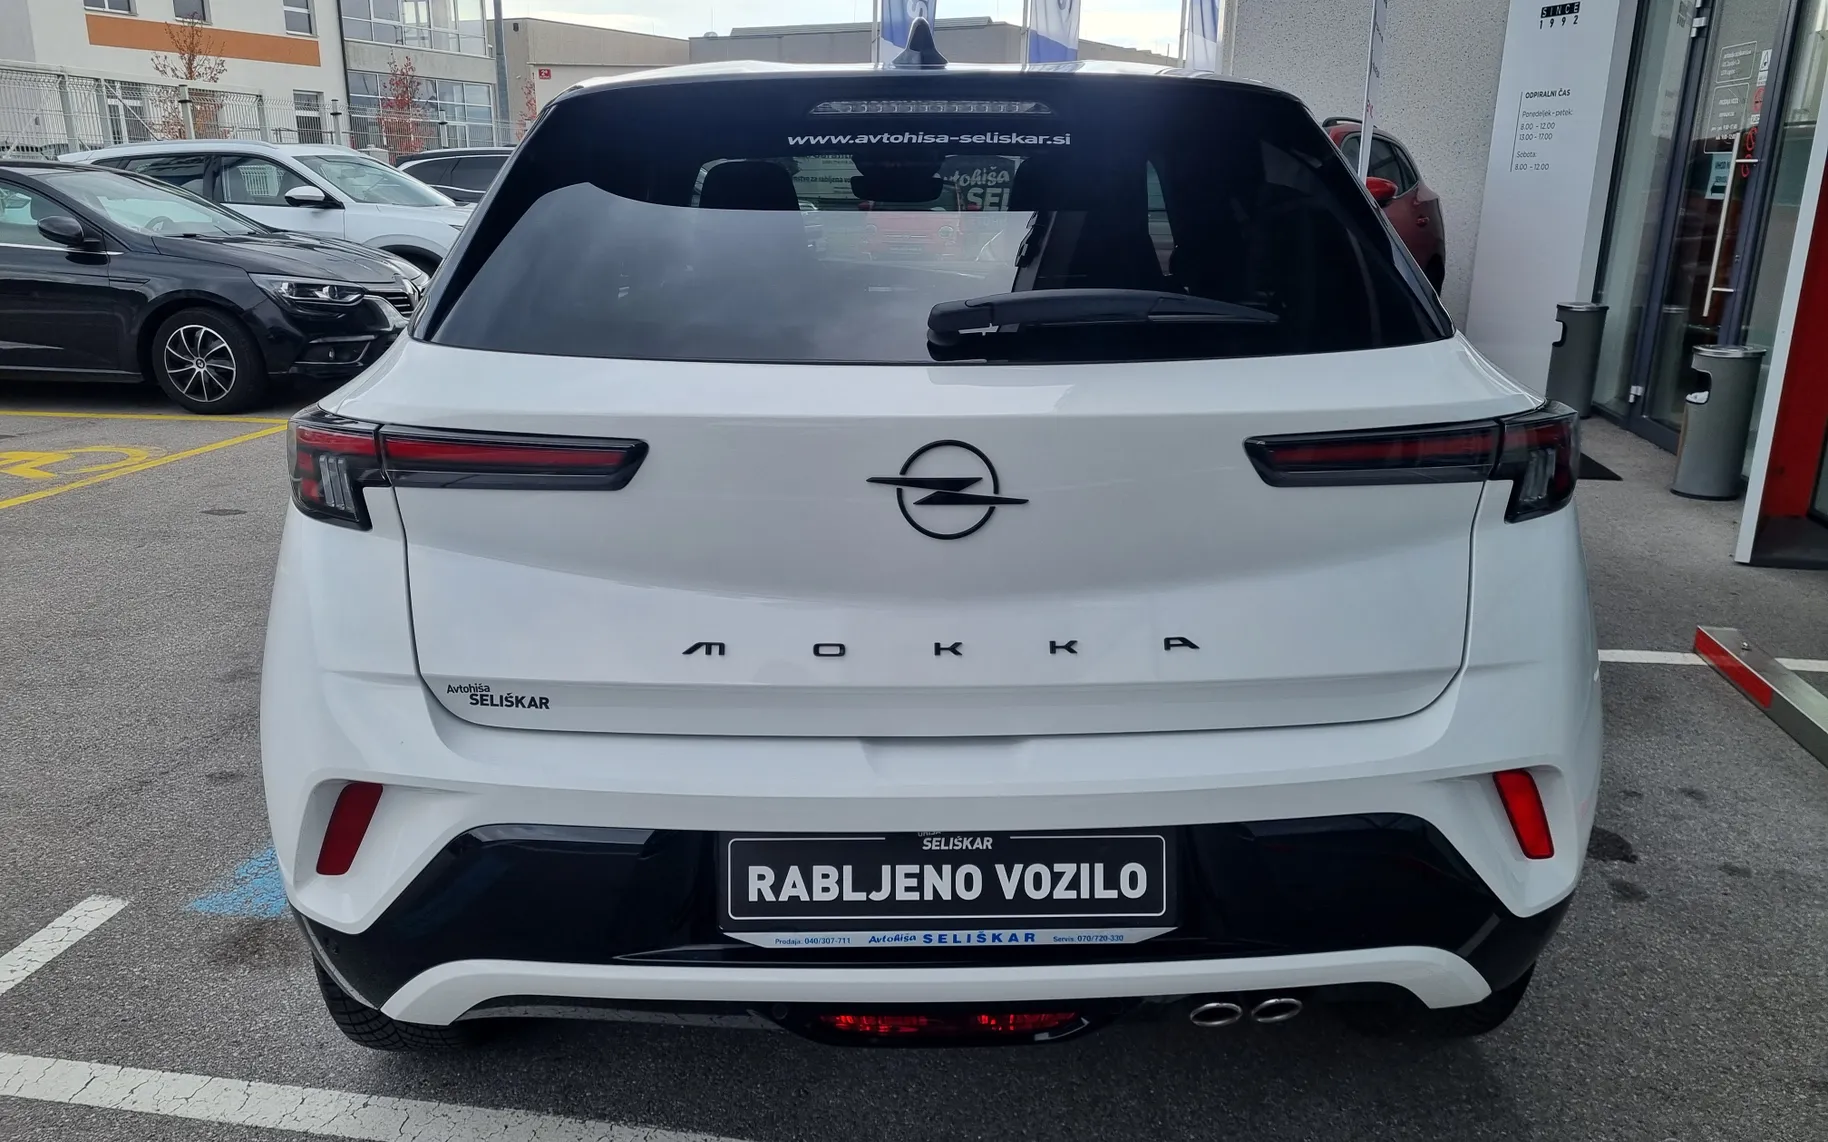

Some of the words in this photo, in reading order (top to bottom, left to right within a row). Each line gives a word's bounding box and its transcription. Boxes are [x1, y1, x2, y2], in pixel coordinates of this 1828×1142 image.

[1542, 2, 1579, 18] SINCE
[1540, 15, 1578, 29] 1992
[1525, 90, 1557, 99] ODPIRALNI
[1558, 87, 1571, 97] ČAS
[1522, 110, 1551, 118] Ponedeljek
[1540, 122, 1555, 130] 12.00
[787, 132, 1071, 145] www.avtohisa-seliskar.si
[1519, 133, 1533, 141] 13.00
[1514, 163, 1528, 171] 8.00
[1534, 163, 1550, 171] 12.00
[682, 637, 1200, 657] MOKKA
[446, 683, 491, 694] Avtohiša
[469, 693, 550, 710] SELIŠKAR
[922, 835, 993, 850] SELIŠKAR
[748, 863, 983, 902] RABLJENO
[994, 862, 1148, 900] VOZILO
[804, 937, 851, 945] 040/307-711
[868, 933, 917, 943] Avtohiša
[922, 931, 1036, 944] SELIŠKAR
[1077, 934, 1124, 942] 070/720-330
